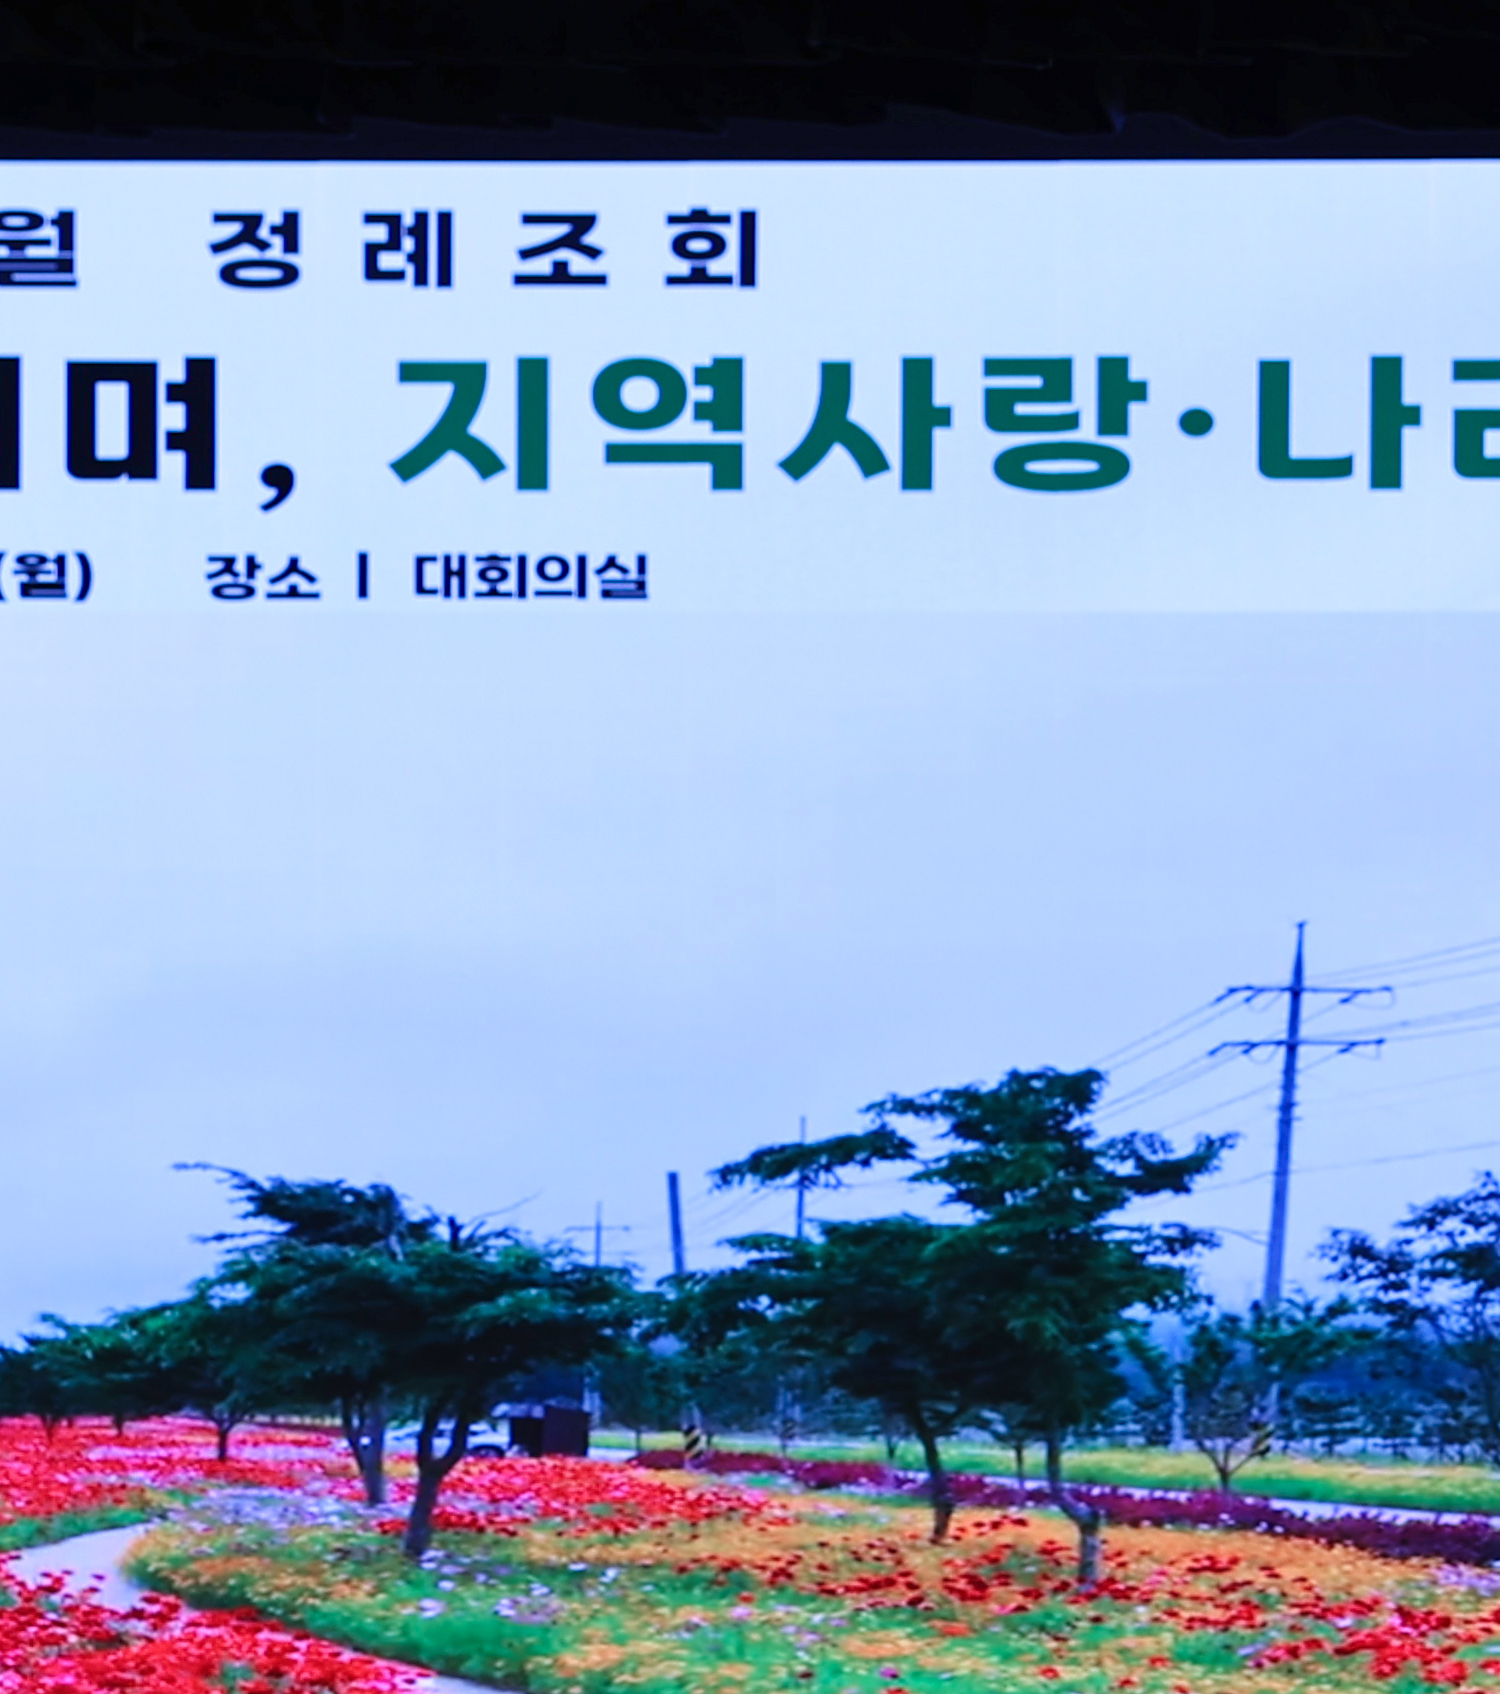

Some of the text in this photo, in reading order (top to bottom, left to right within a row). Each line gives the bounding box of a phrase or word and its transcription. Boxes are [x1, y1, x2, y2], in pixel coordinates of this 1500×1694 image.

[207, 207, 757, 289] 정례조회
[204, 553, 321, 601] 장소
[413, 553, 649, 600] 대회의실
